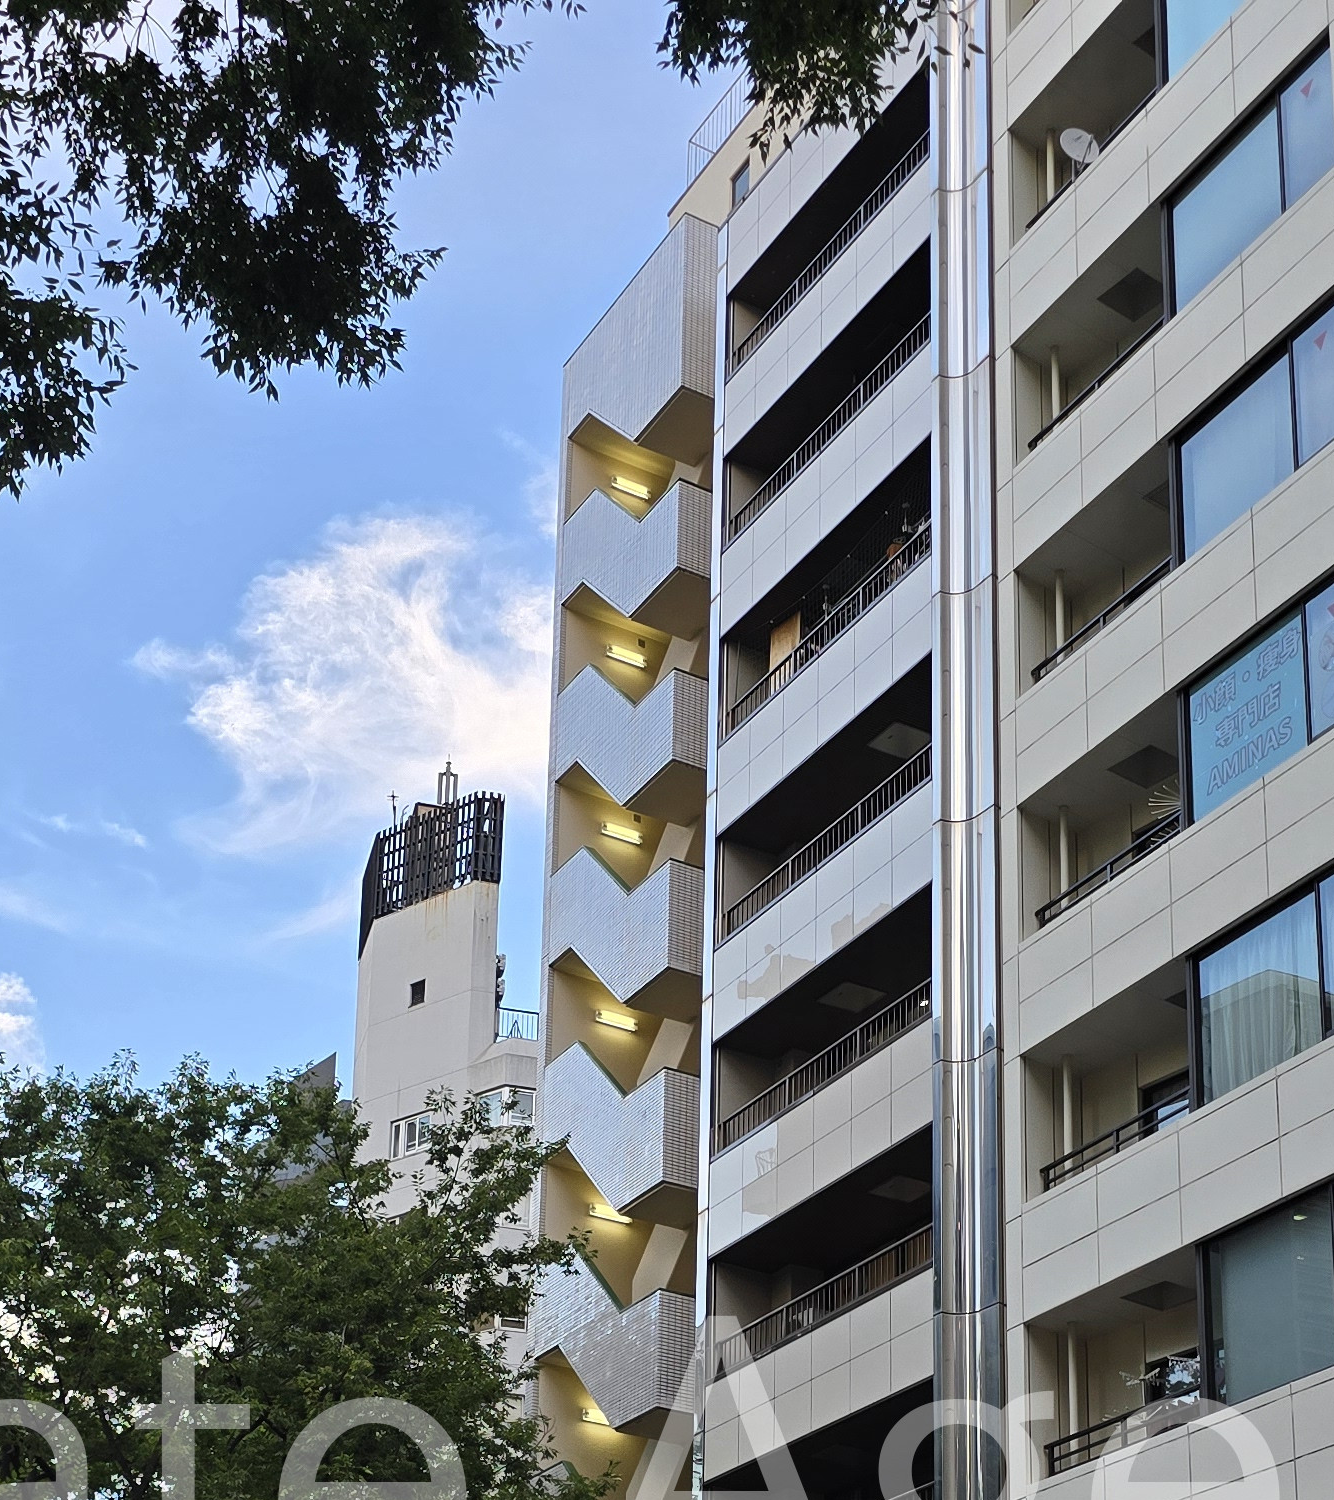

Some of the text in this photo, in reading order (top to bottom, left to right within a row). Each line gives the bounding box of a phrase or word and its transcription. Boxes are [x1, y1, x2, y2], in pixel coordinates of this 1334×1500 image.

[1193, 627, 1302, 725] 小顔・痩身
[1215, 682, 1282, 748] 専門店
[1207, 716, 1293, 796] AMINAS
